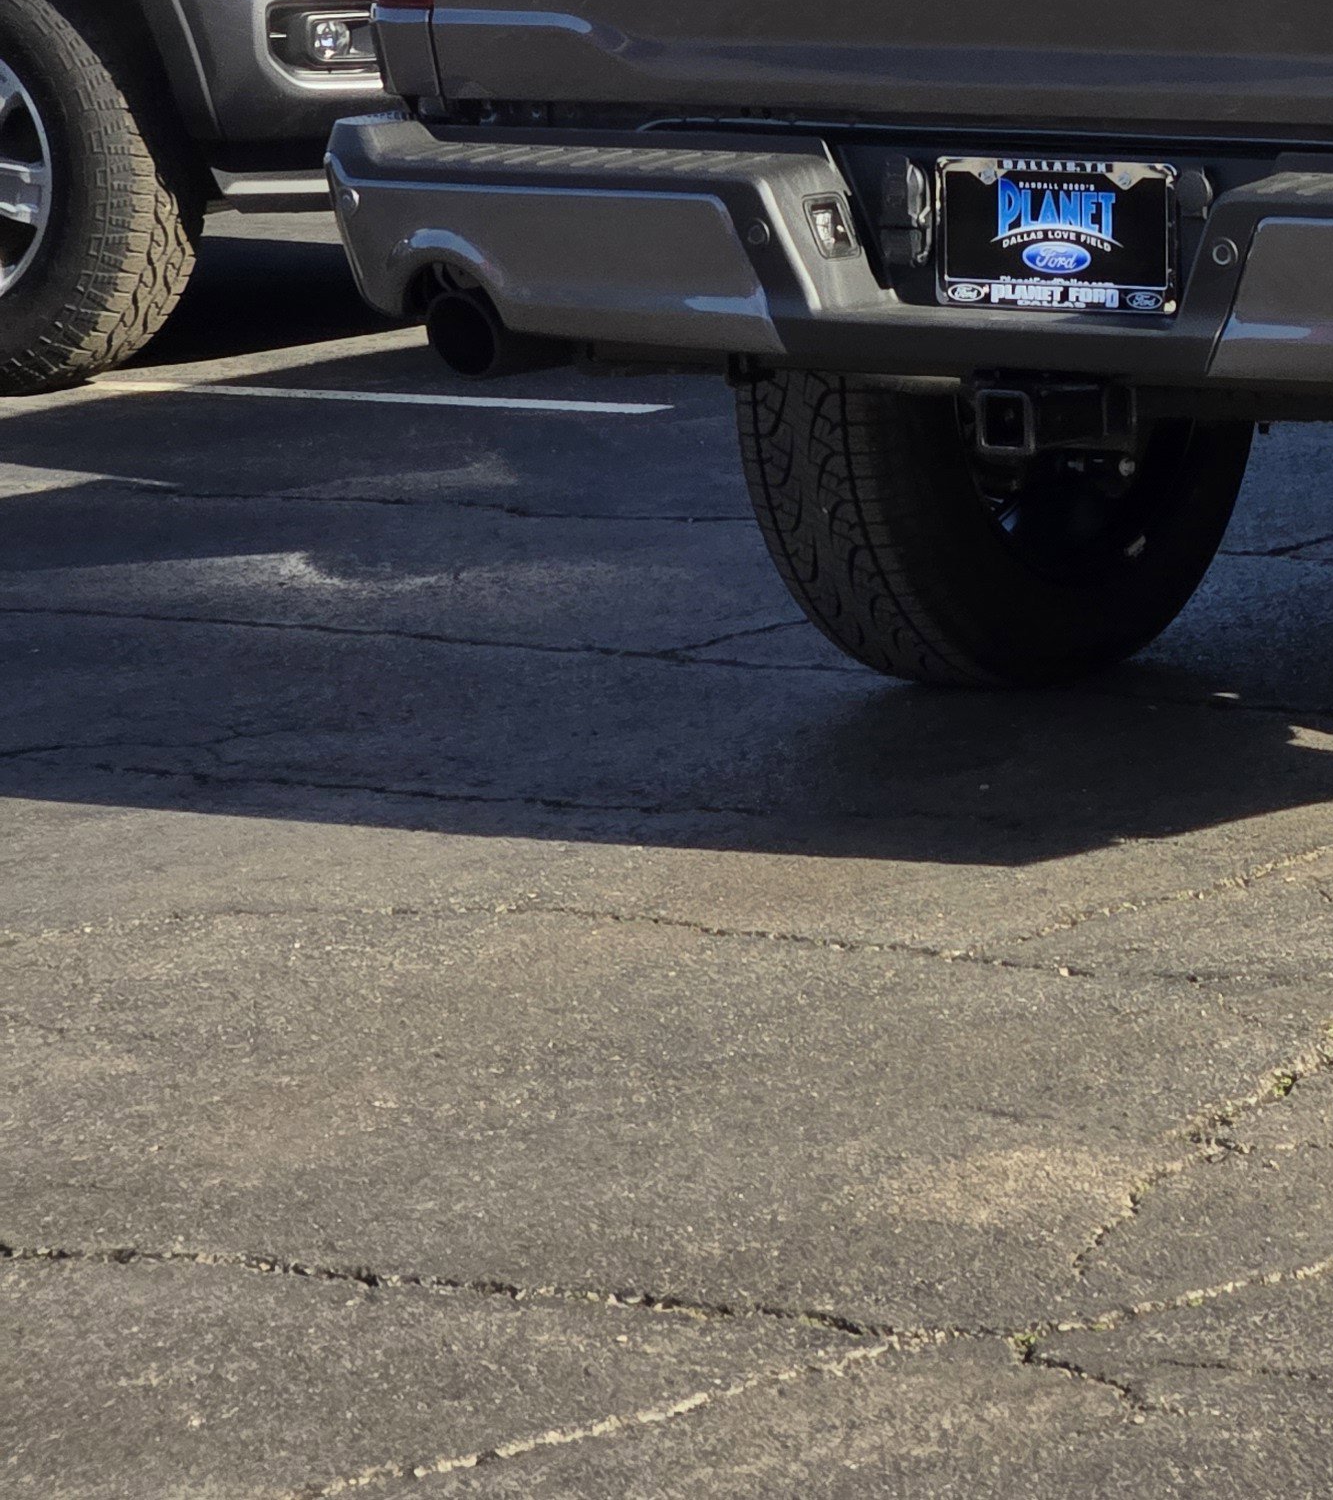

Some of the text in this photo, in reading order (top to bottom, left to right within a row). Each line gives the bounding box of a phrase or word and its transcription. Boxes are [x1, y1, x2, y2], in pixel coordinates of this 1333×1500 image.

[997, 177, 1117, 239] PLANET
[1002, 230, 1112, 252] DALLAS LOVE FIELD
[1036, 247, 1077, 270] Ford
[990, 283, 1120, 308] PLANET FORD
[1017, 299, 1086, 309] DALLAS
